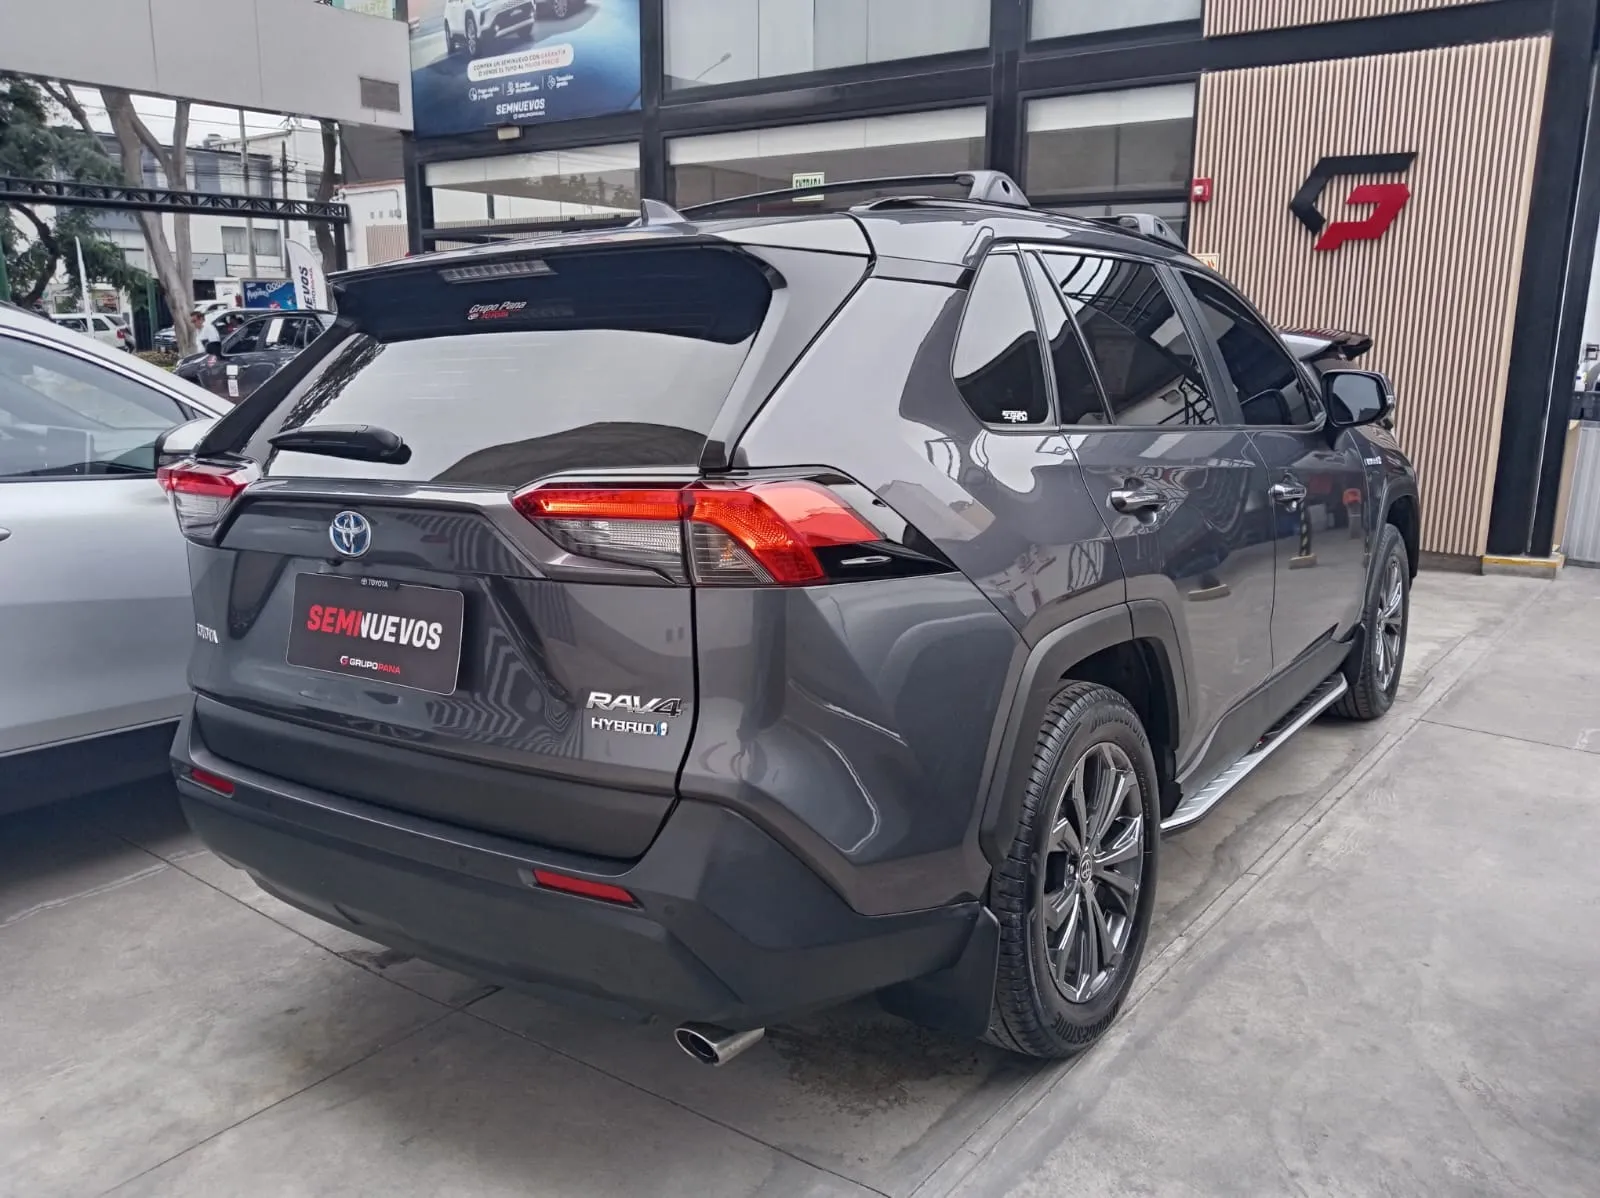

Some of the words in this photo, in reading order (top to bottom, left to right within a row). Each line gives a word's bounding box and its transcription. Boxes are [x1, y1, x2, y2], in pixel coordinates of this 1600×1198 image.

[468, 302, 500, 314] Grupo
[499, 300, 527, 311] Pana
[367, 578, 389, 588] TOYOTA
[307, 603, 443, 650] SEMINUEVOS
[349, 657, 401, 675] GRUPOPANA
[585, 691, 682, 718] RAV4
[591, 717, 655, 735] HYBRID
